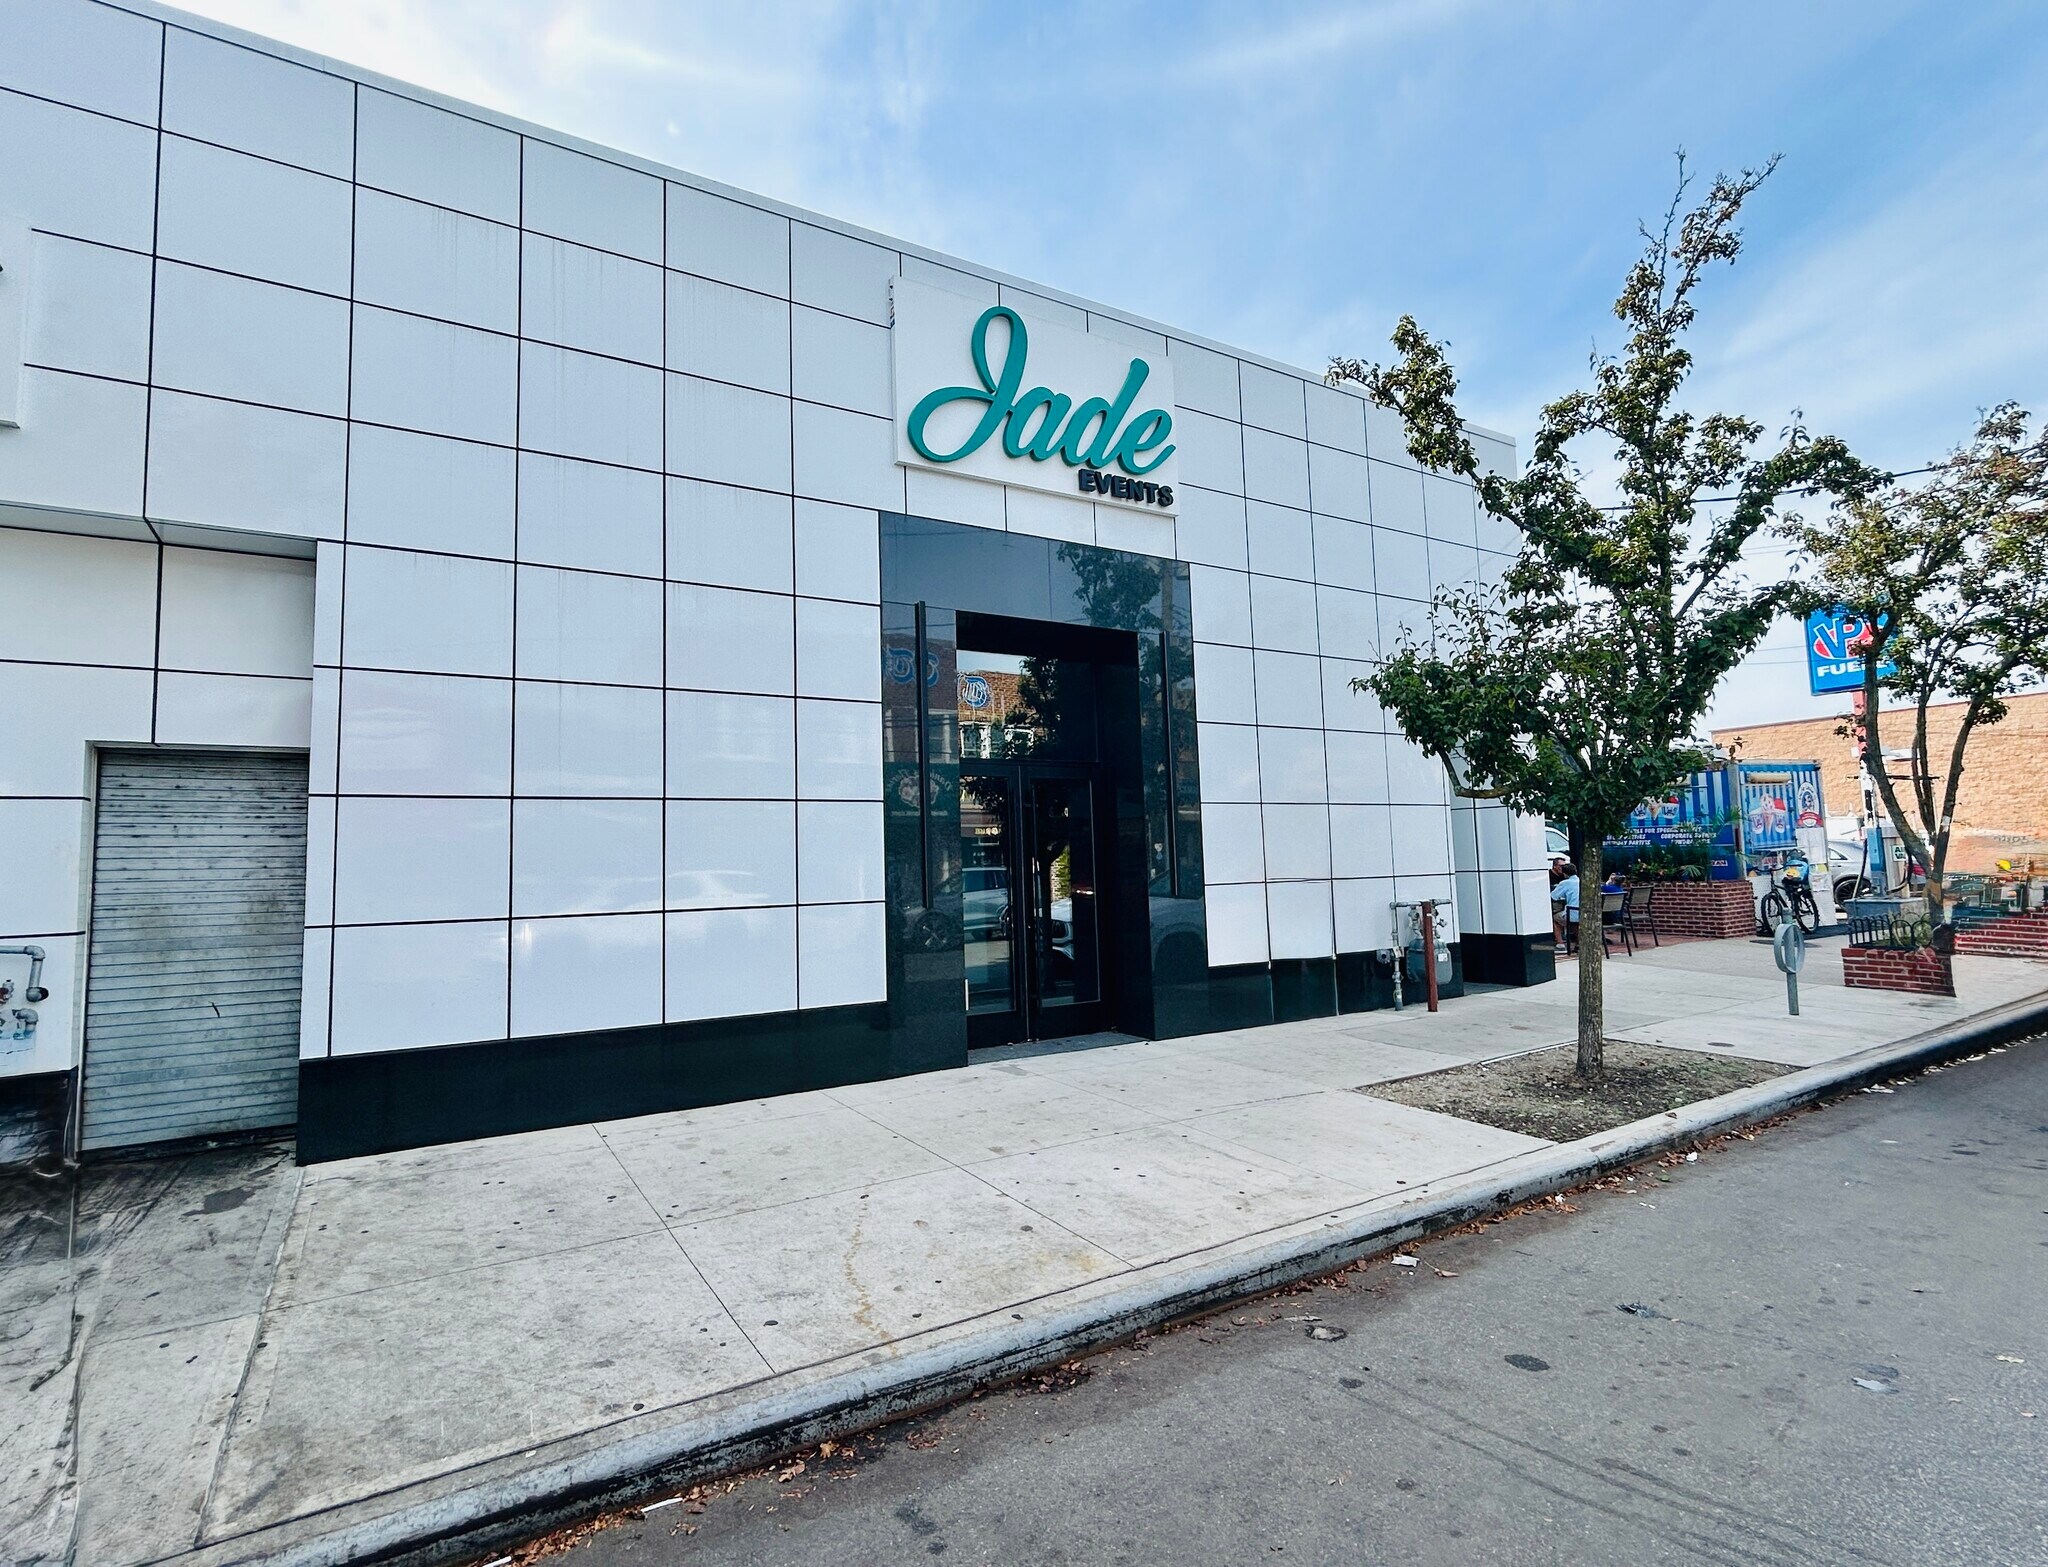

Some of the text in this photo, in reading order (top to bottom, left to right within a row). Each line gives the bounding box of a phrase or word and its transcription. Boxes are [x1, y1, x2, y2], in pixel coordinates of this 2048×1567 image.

[907, 306, 1176, 475] Jade
[1078, 469, 1173, 507] EVENTS
[1813, 617, 1865, 660] VP
